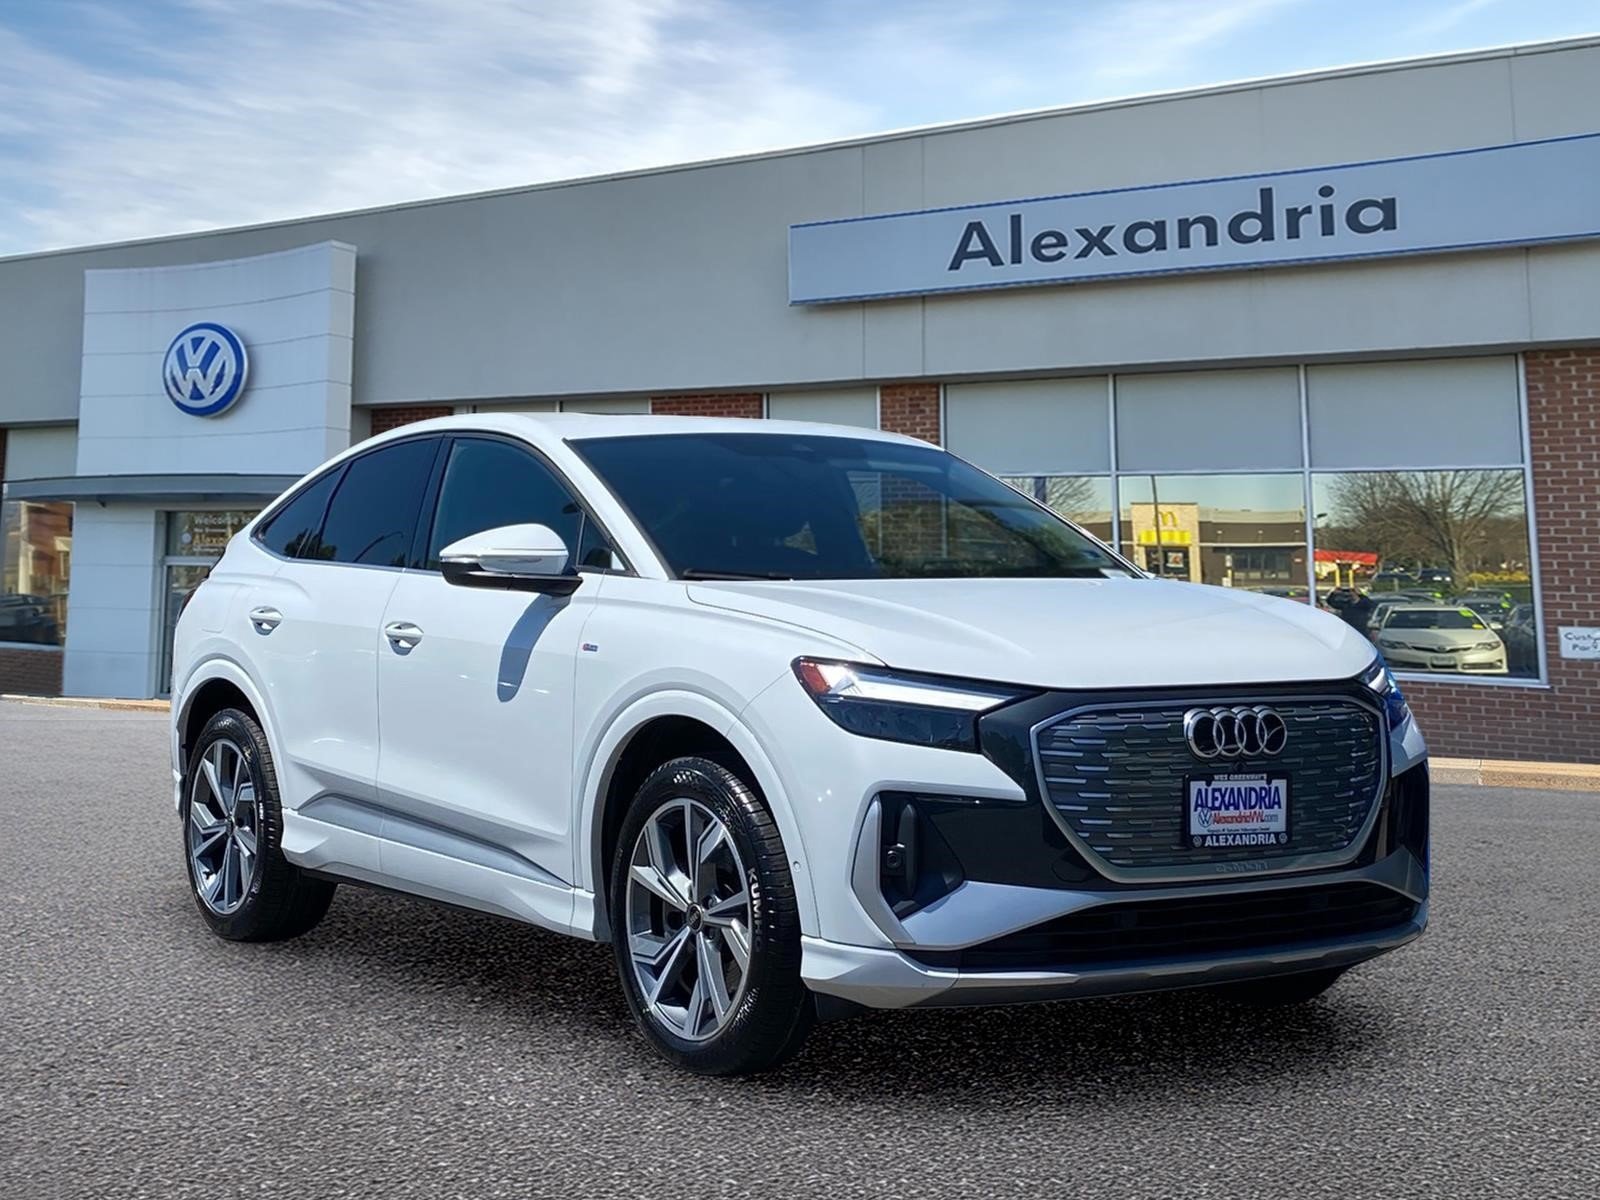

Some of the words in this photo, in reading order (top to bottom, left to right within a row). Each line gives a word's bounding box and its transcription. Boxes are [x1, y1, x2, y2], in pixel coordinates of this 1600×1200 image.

[947, 184, 1398, 272] Alexandria
[194, 515, 239, 525] Welcome
[1194, 786, 1282, 812] ALEXANDRIA
[1204, 833, 1277, 847] ALEXANDRIA
